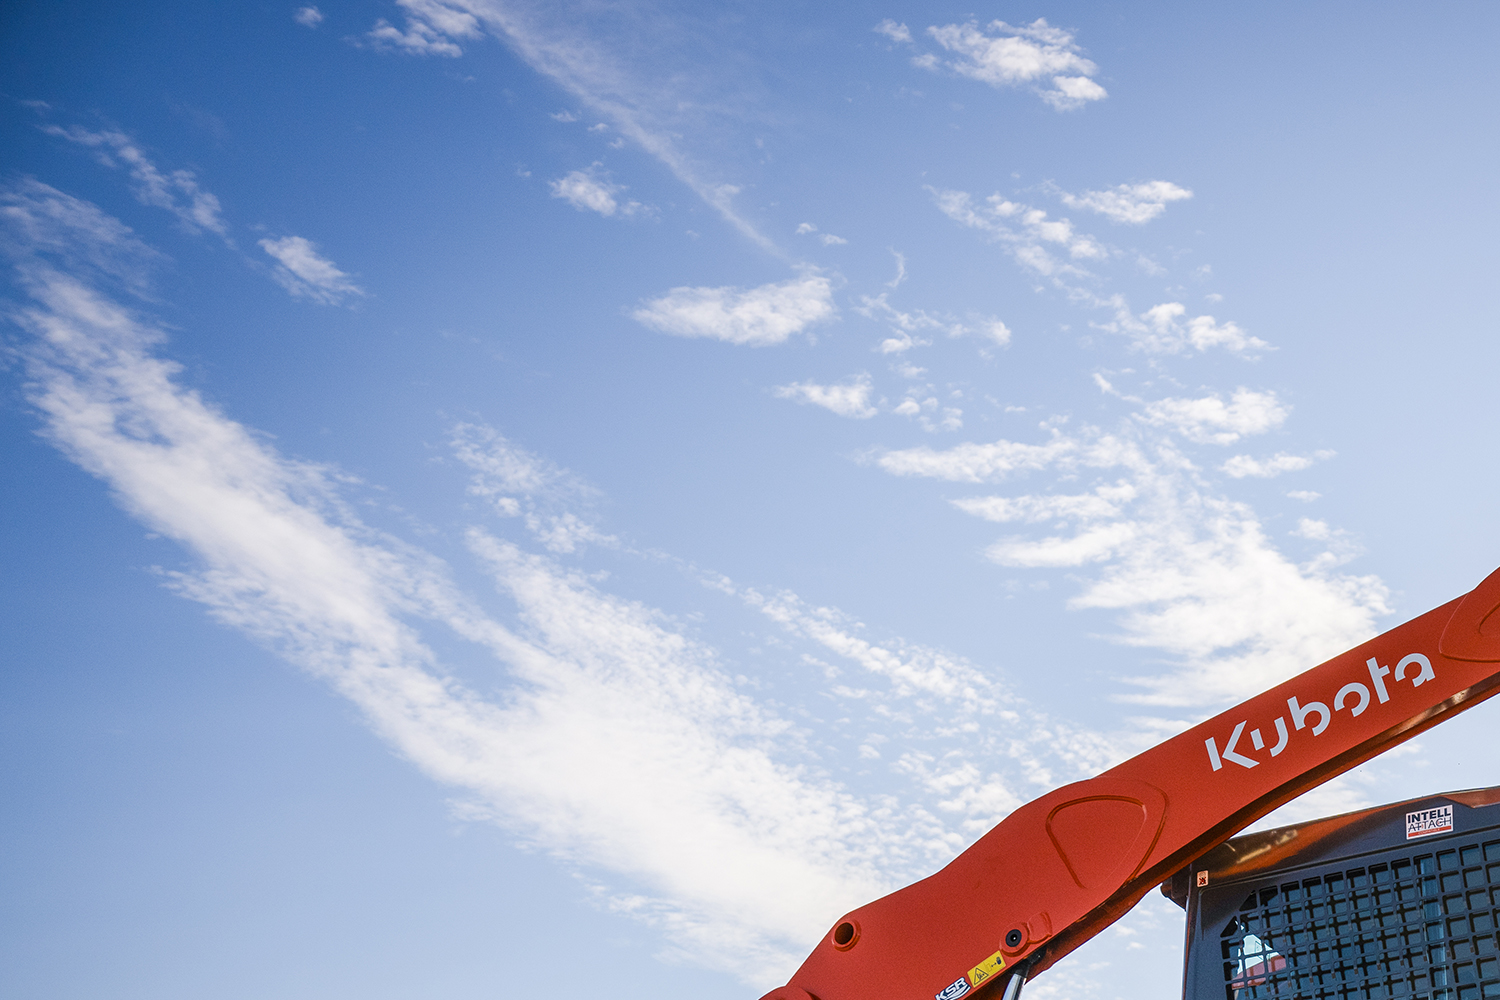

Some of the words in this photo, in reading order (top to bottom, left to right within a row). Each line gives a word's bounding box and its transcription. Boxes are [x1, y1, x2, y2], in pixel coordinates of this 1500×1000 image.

[1205, 653, 1435, 771] Kubota
[1408, 808, 1451, 823] INTELL
[1408, 817, 1452, 832] ATTACH
